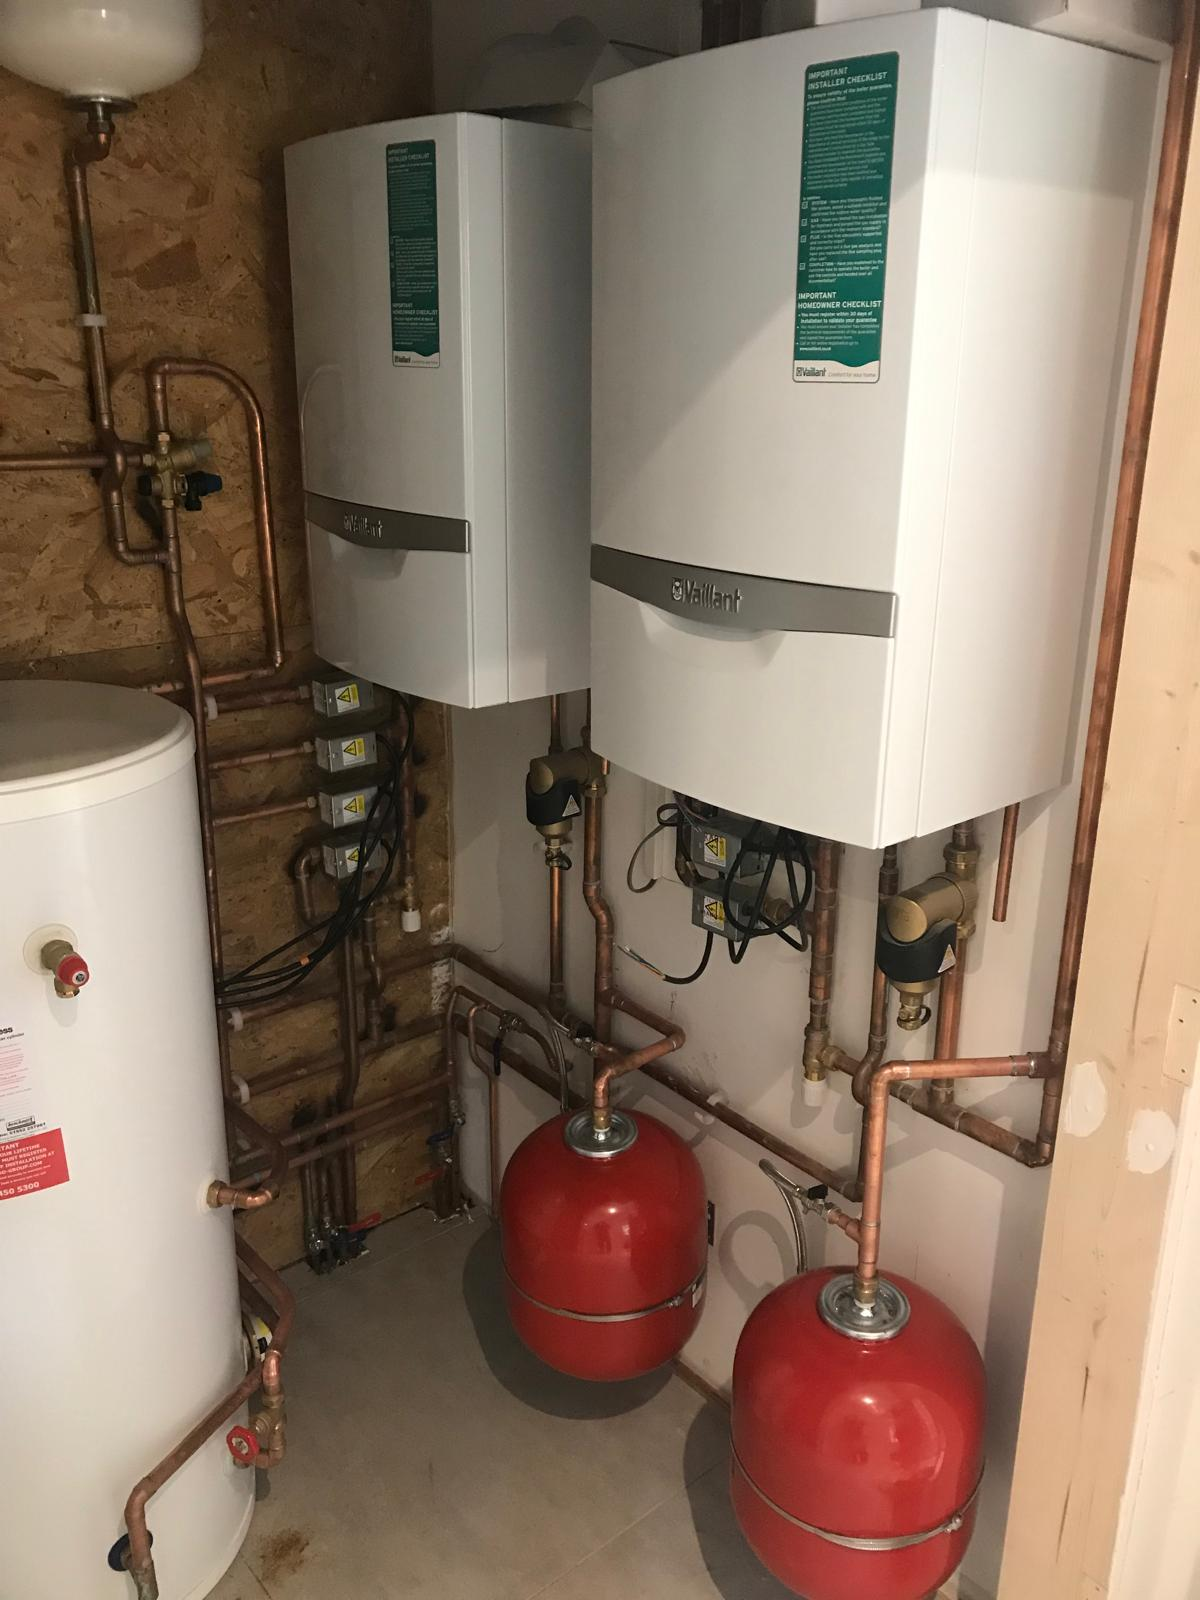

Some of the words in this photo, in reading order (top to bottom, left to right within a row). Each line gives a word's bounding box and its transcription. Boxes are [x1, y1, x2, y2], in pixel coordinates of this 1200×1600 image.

[808, 66, 848, 79] IMPORTANT
[807, 78, 845, 90] INSTALLER
[846, 71, 888, 84] CHECKLIST
[798, 301, 841, 309] HOMEOWNER
[842, 300, 882, 308] CHECKLIST
[803, 367, 827, 377] Vaillant
[684, 578, 743, 614] Vaillant
[0, 1142, 20, 1151] TANT
[13, 1144, 40, 1155] LIFETIME
[1, 1155, 18, 1163] MUST
[19, 1147, 47, 1159] REGISTER
[5, 1153, 47, 1168] INSTALLATION
[16, 1181, 40, 1193] 5300
